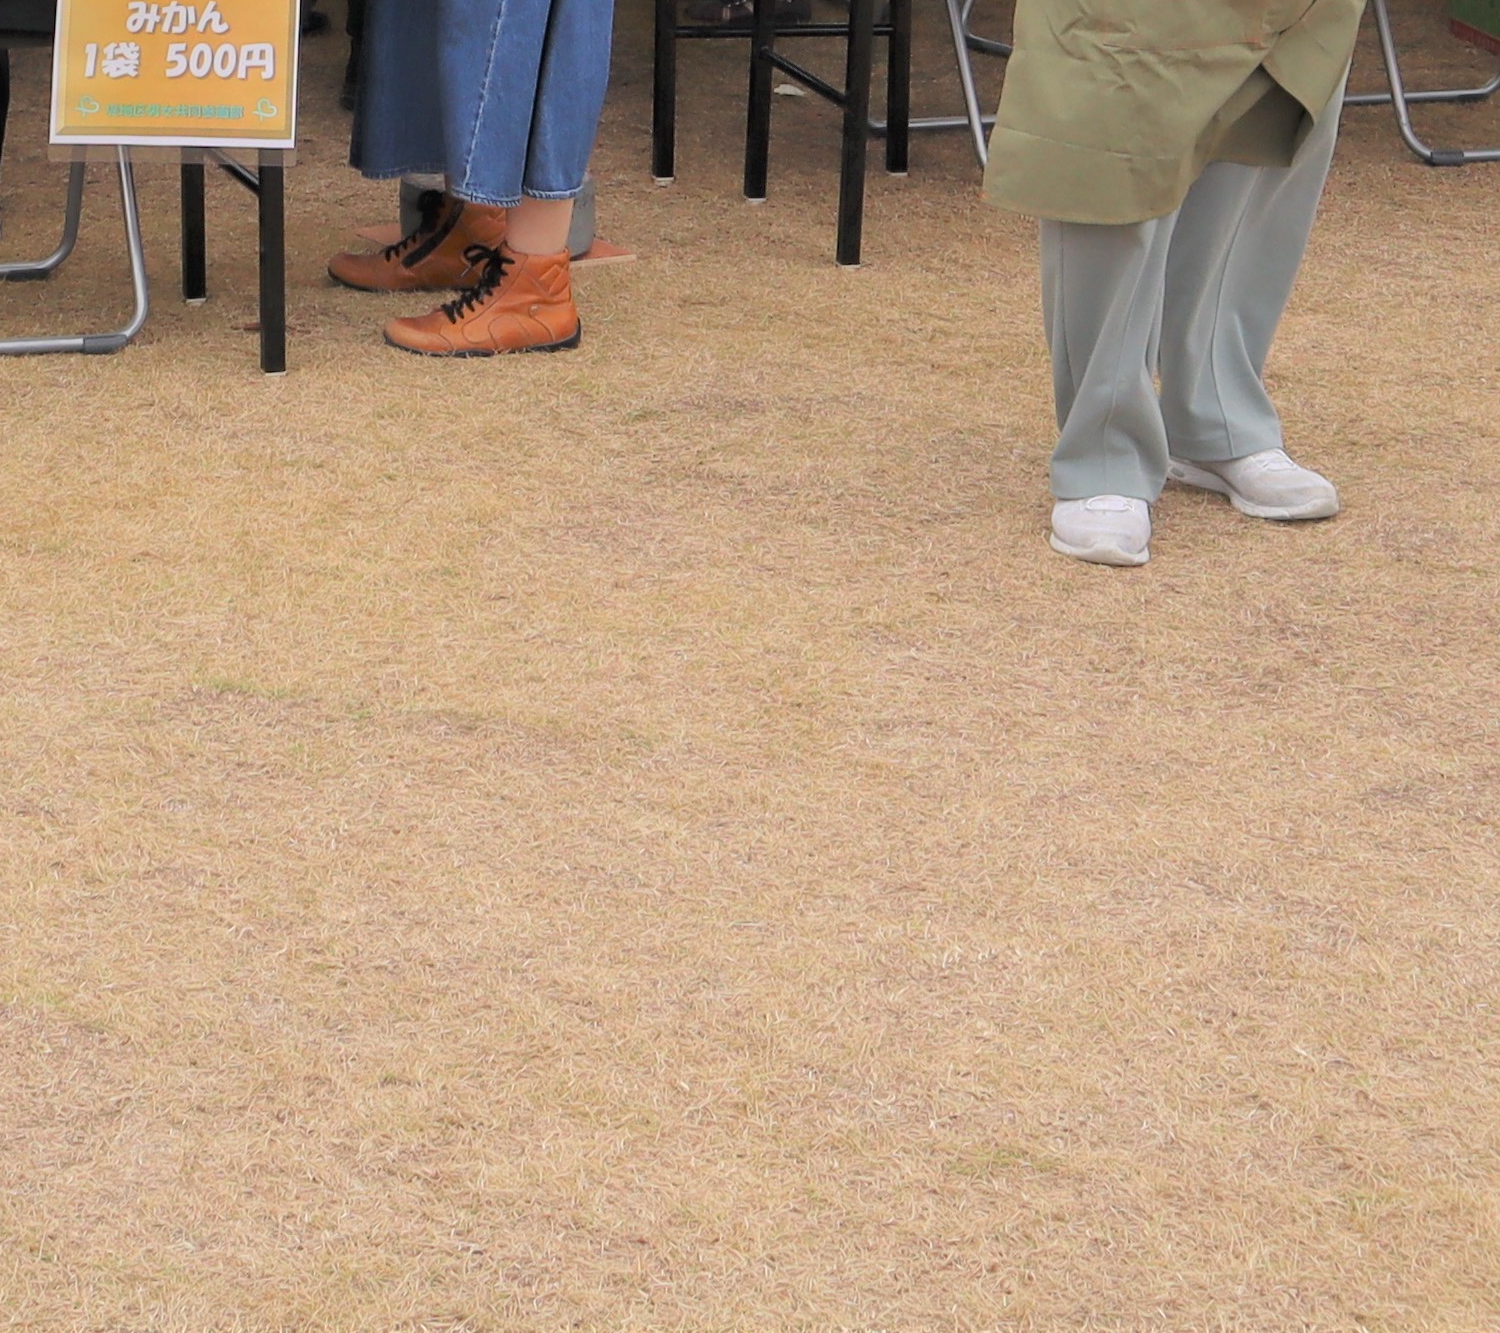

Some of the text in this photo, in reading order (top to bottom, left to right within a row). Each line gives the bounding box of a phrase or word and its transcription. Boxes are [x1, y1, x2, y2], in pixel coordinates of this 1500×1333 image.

[126, 0, 229, 34] みかん
[84, 42, 275, 80] 1袋 500円
